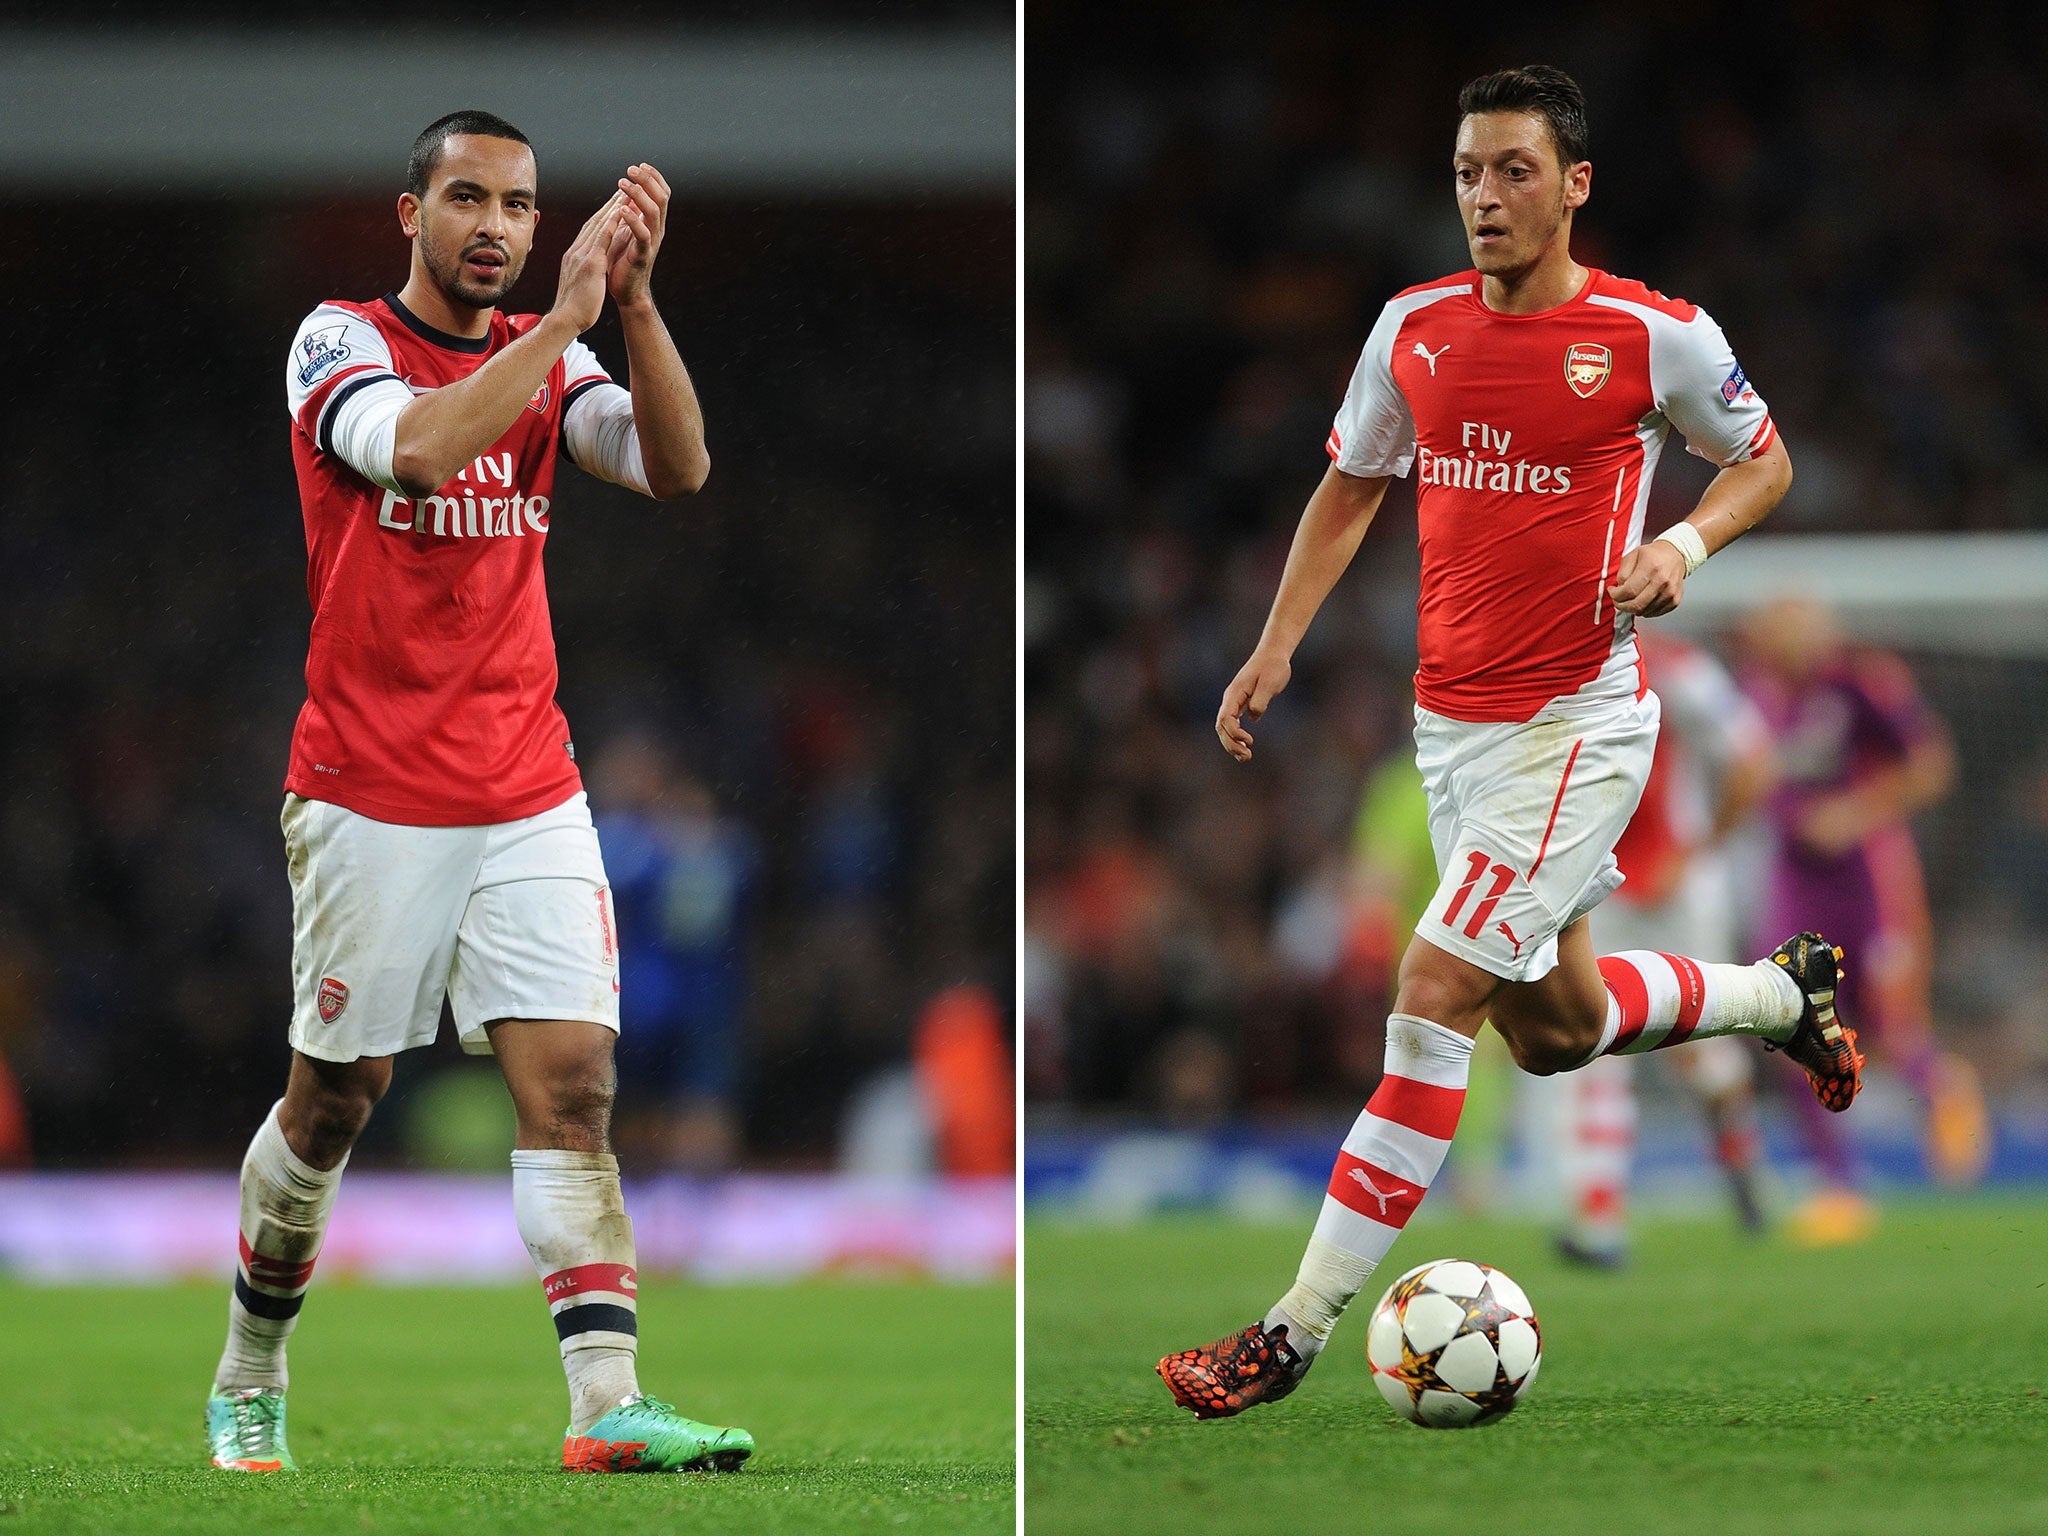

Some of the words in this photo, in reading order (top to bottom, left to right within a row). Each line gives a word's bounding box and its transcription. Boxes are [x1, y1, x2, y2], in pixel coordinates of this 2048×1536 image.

[302, 350, 334, 378] BARCLAYS
[1571, 351, 1606, 363] Arsenal
[1462, 421, 1511, 456] Fly
[1419, 446, 1571, 495] Emirates
[314, 763, 340, 776] DRI-FIT
[1442, 850, 1516, 940] 11
[595, 885, 617, 965] 1
